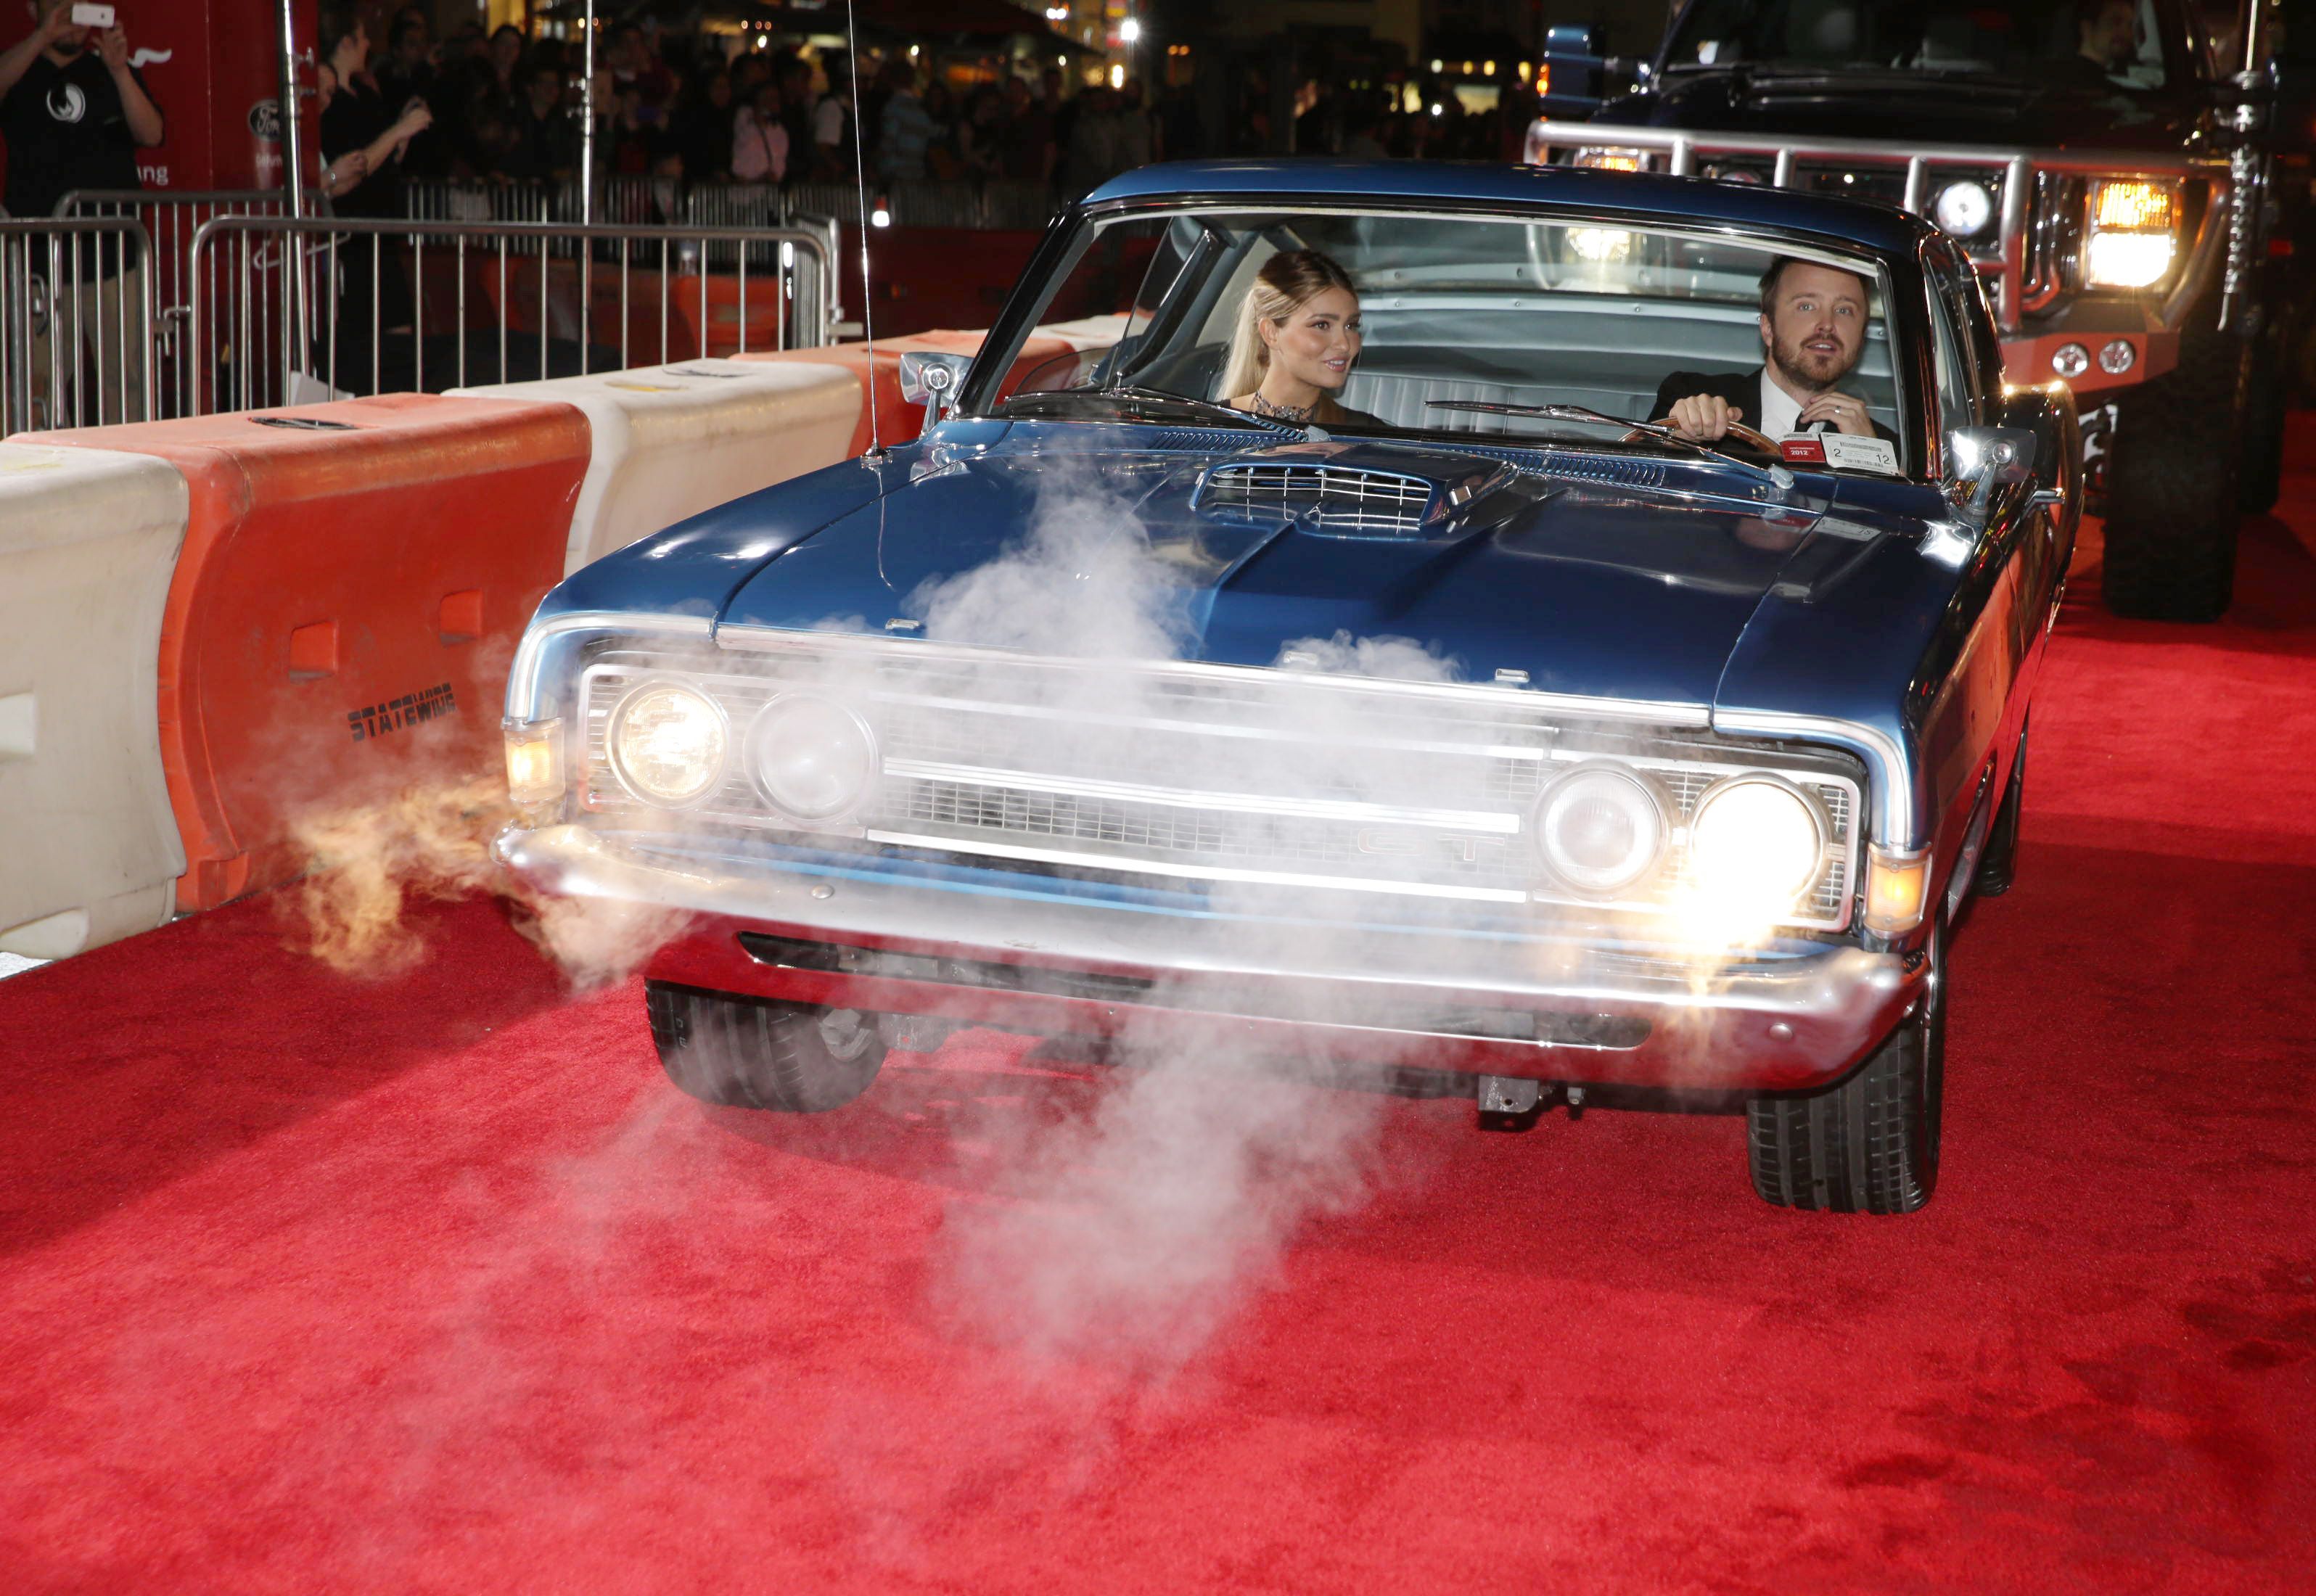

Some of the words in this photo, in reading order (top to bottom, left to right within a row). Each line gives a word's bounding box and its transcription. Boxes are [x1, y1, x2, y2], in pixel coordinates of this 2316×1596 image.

[1834, 448, 1842, 458] 2
[1876, 454, 1891, 465] 12
[348, 682, 456, 742] STATEWIDE
[1358, 827, 1505, 861] GT
